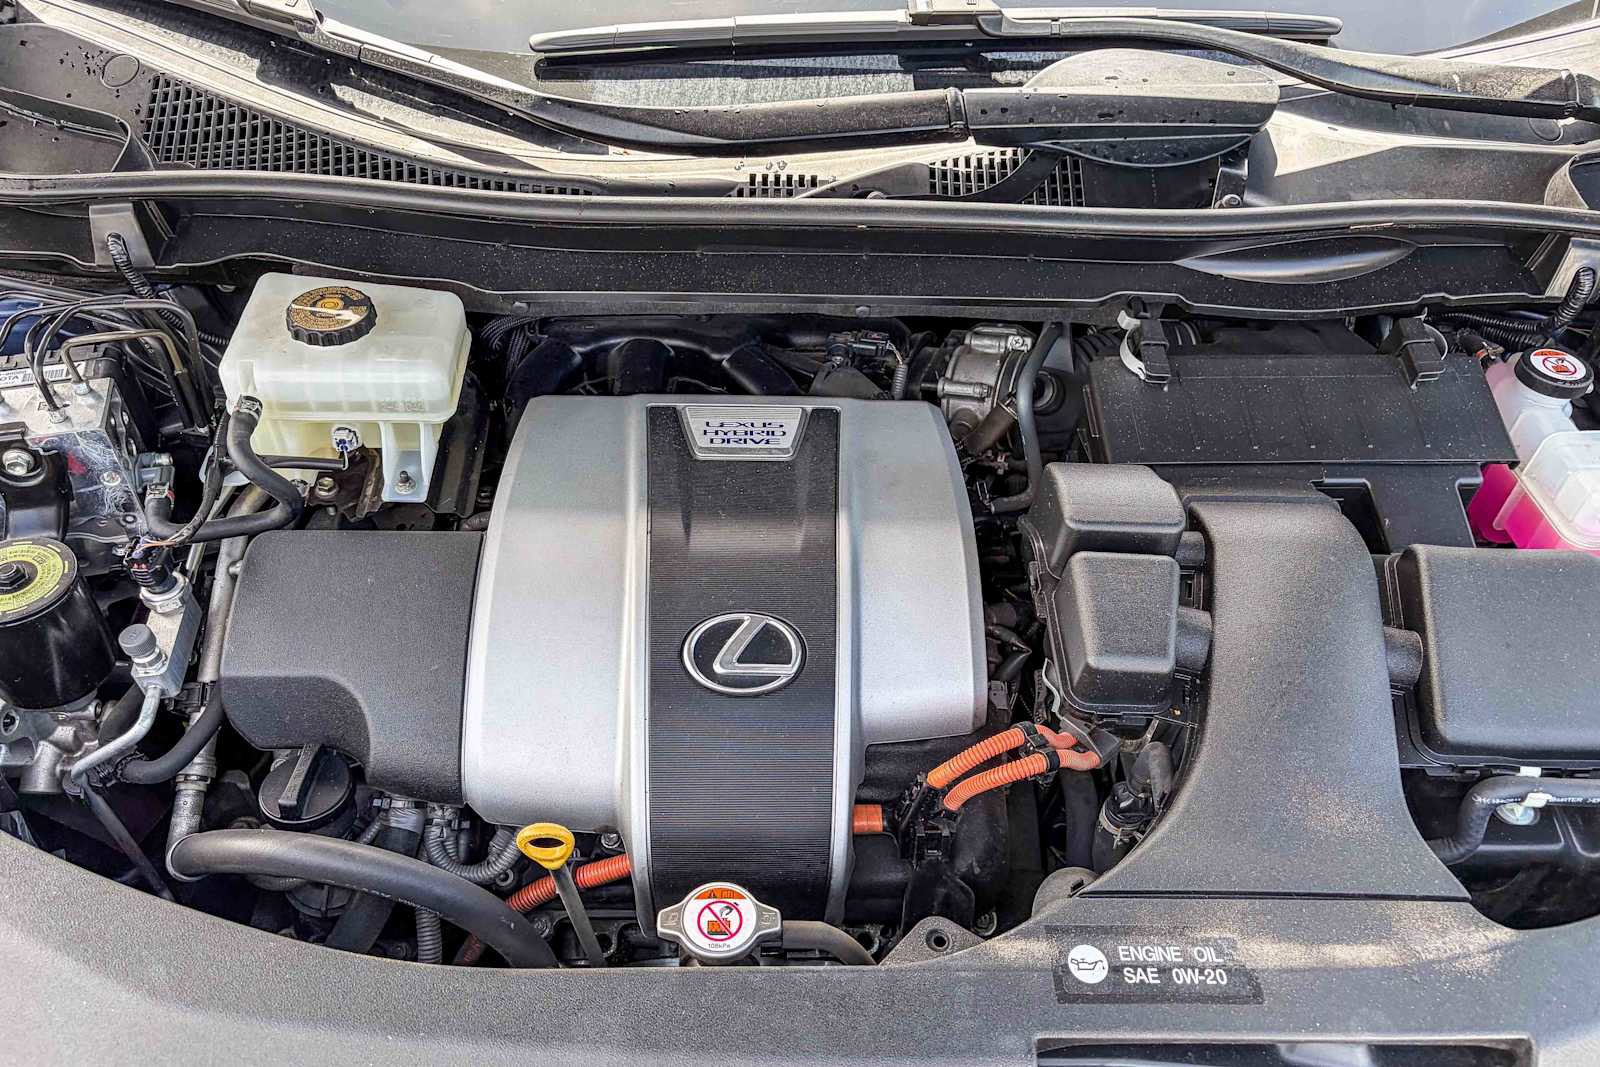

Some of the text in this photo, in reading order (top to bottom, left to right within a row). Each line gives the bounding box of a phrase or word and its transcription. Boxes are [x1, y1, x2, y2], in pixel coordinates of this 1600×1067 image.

[703, 429, 787, 437] HYBRID
[1118, 945, 1225, 963] ENGINE OIL
[1122, 967, 1228, 985] SAE 0W-20
